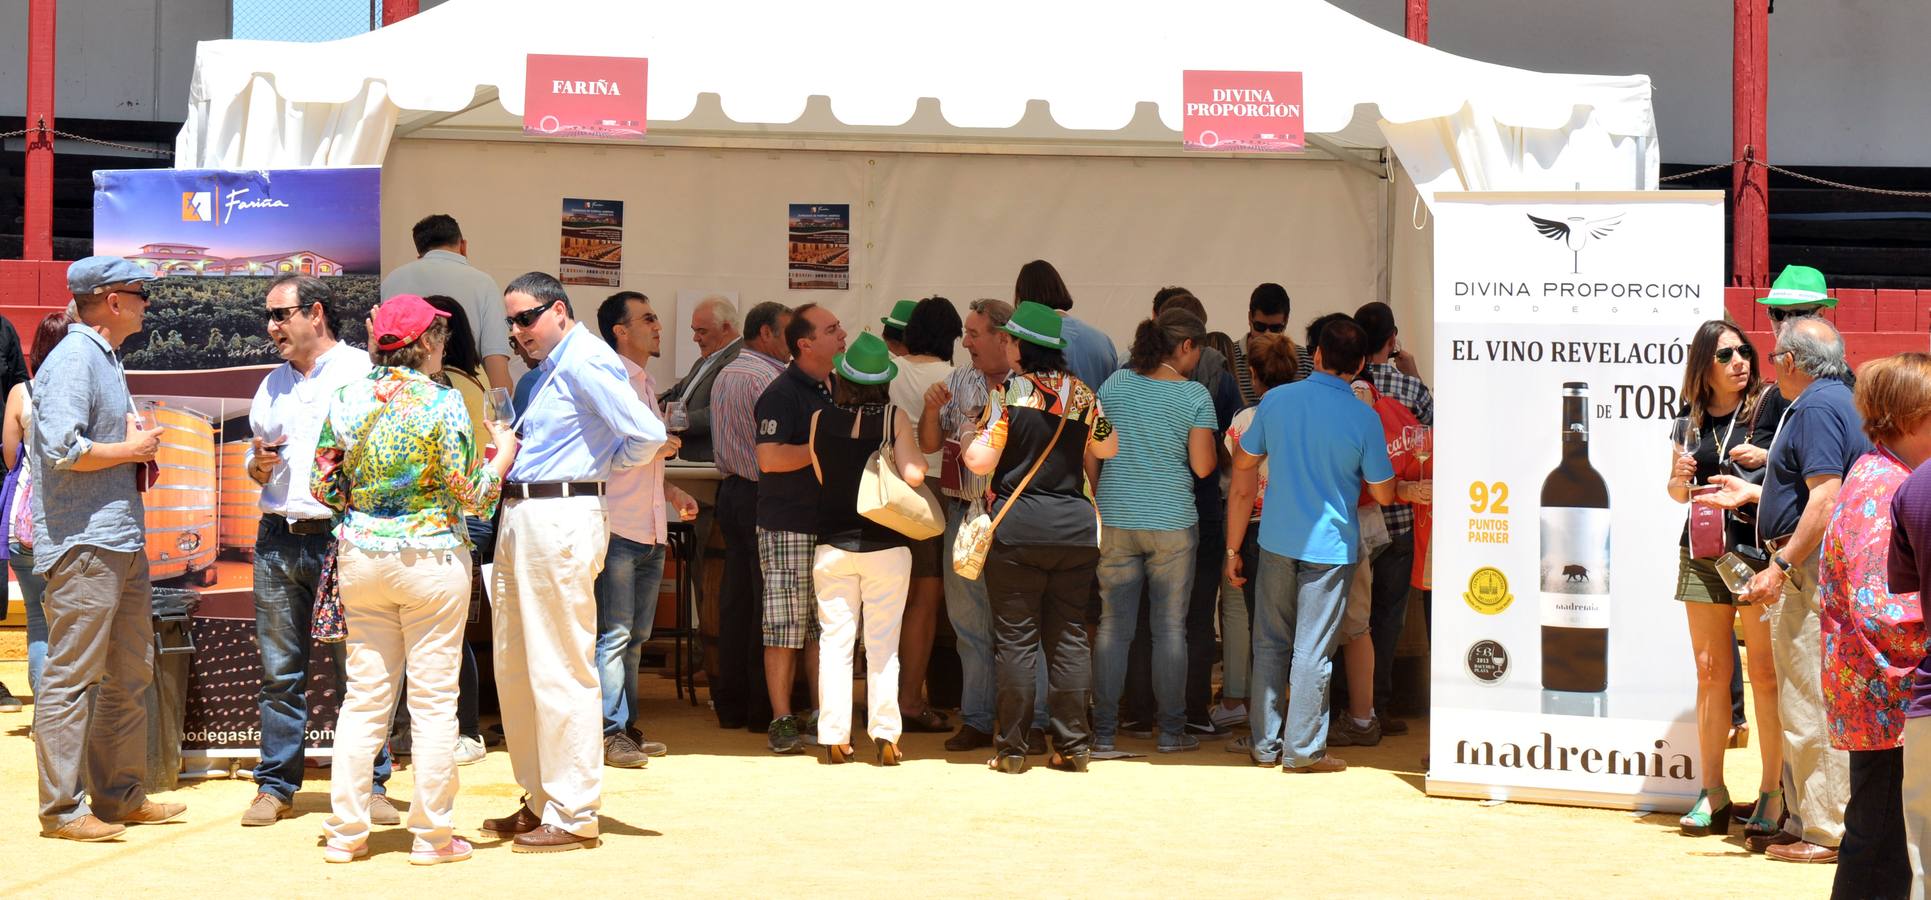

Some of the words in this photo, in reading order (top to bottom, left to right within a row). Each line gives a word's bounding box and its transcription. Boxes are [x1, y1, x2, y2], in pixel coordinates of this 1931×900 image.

[552, 79, 621, 96] FARIÑA
[1213, 88, 1274, 103] DIVINA
[1186, 102, 1301, 118] PROPORCIÓN
[224, 188, 289, 224] Fariña
[1455, 282, 1530, 297] DIVINA
[1452, 340, 1479, 361] EL
[1485, 340, 1543, 362] VINO
[1596, 404, 1612, 419] DE
[1614, 384, 1684, 420] TOR
[760, 419, 777, 435] 08
[1469, 480, 1509, 514] 92
[1468, 519, 1509, 532] PUNTOS
[1468, 531, 1509, 544] PARKER
